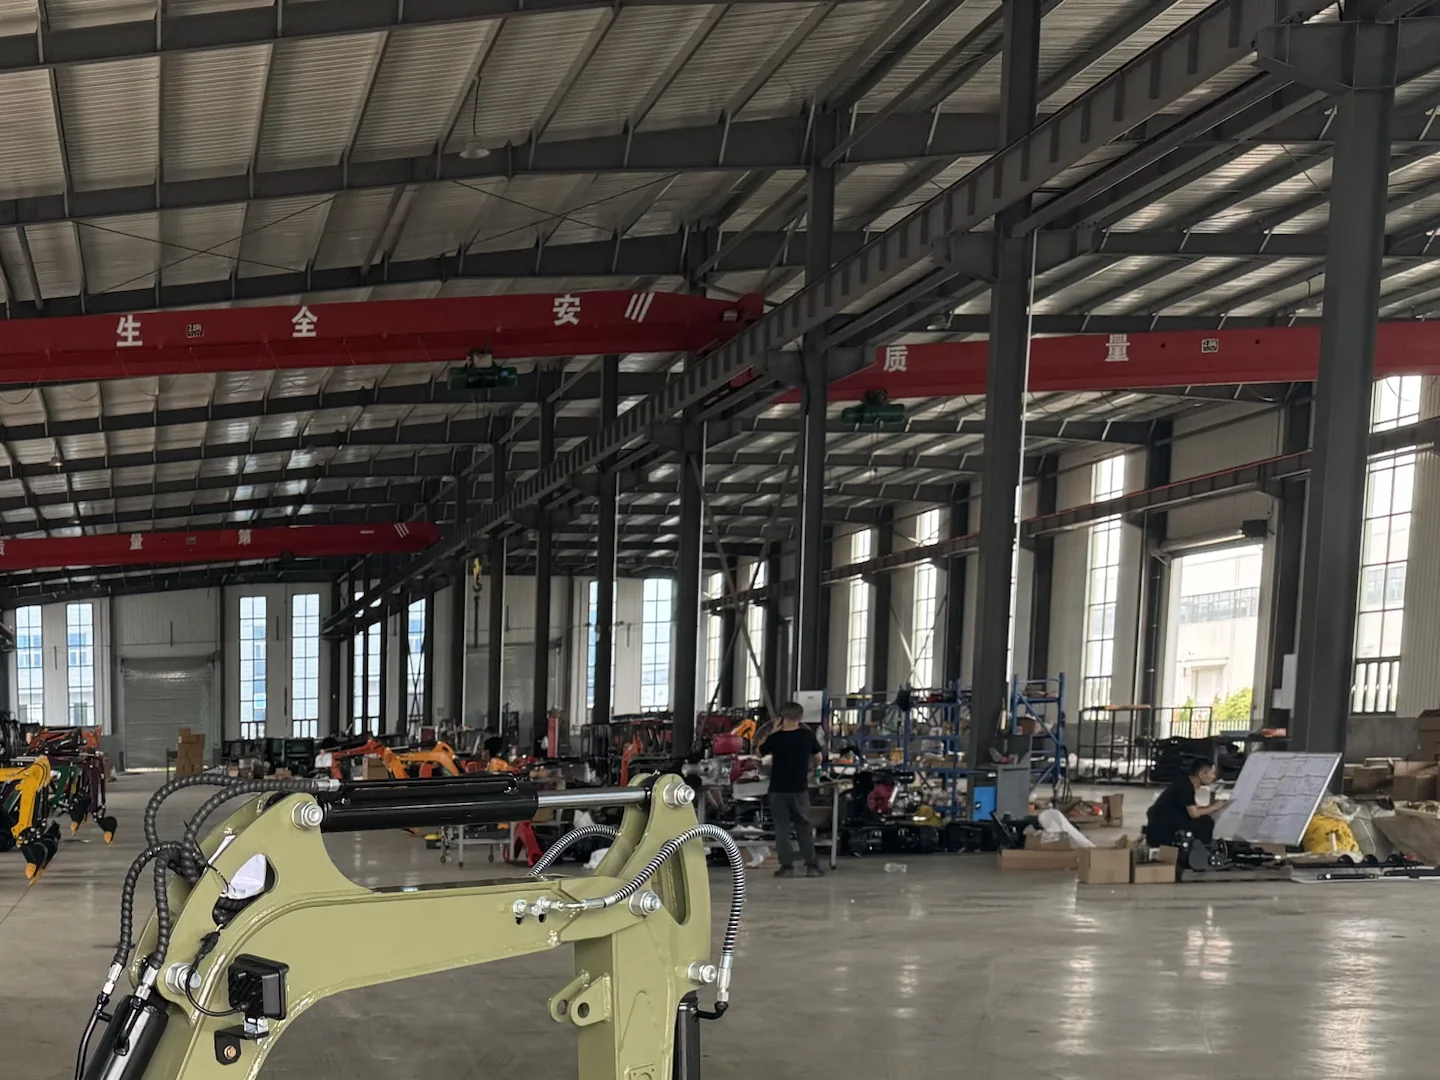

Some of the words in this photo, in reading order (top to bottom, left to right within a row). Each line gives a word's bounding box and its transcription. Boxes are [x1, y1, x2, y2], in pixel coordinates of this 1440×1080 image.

[116, 314, 144, 348] 生
[291, 305, 318, 338] 全
[553, 293, 581, 327] 安
[883, 345, 908, 373] 质
[1105, 333, 1131, 362] 量
[129, 533, 144, 550] 量
